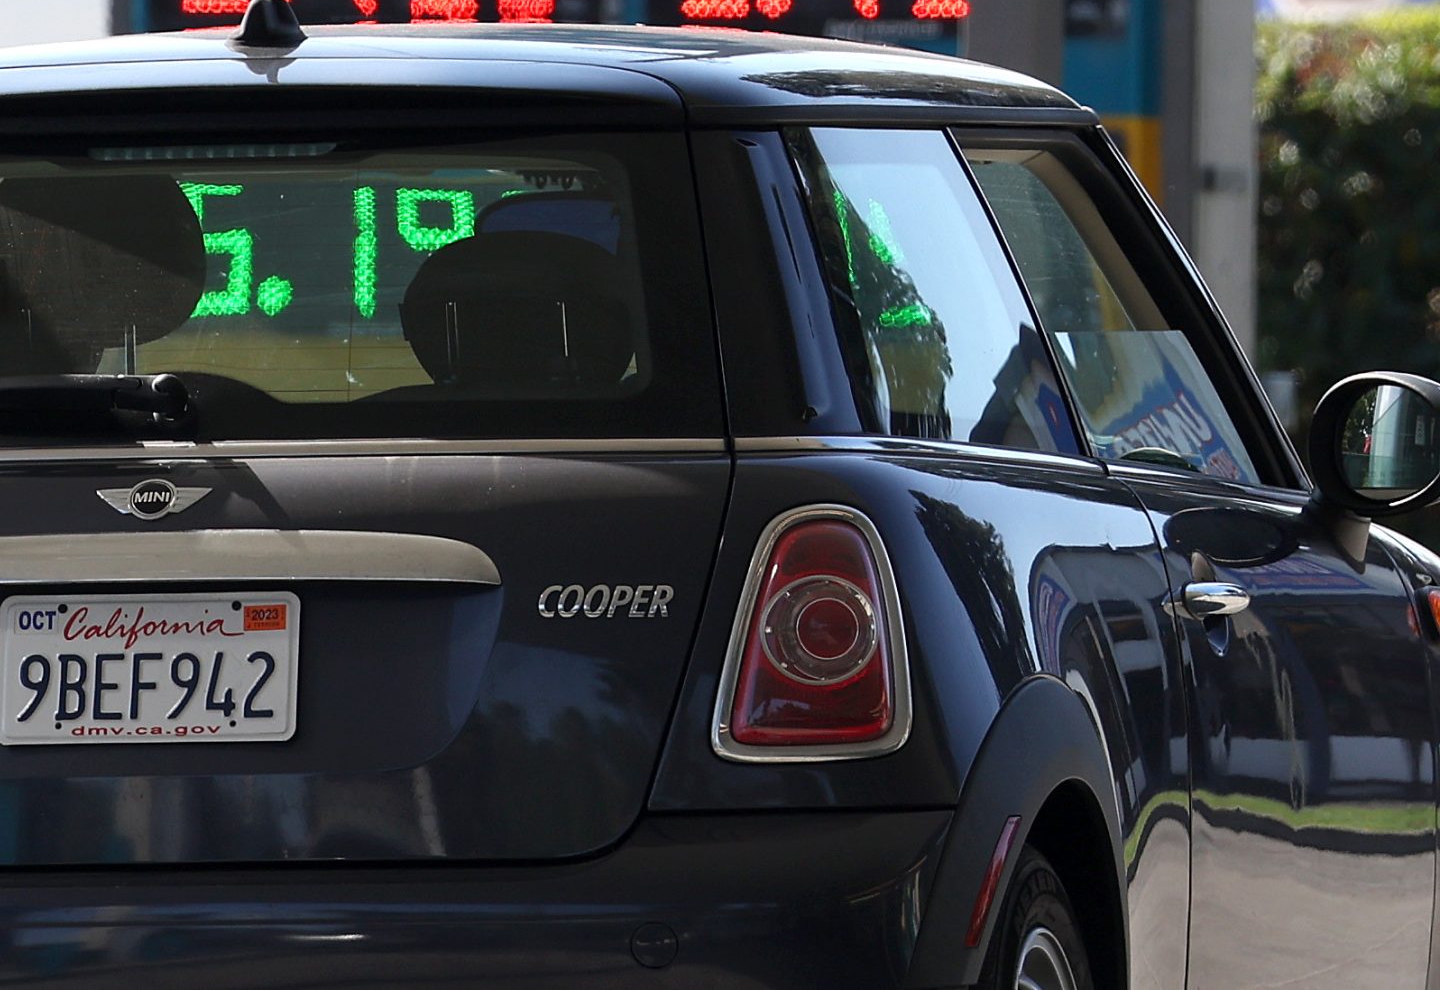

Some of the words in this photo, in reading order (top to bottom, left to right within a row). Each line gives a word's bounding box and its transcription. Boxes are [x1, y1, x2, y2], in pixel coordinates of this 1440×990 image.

[134, 491, 171, 503] MINI
[538, 584, 675, 618] COOPER
[19, 611, 56, 631] OCT
[251, 609, 279, 621] 2023
[63, 607, 245, 649] California
[17, 651, 276, 723] 9BEF942
[71, 725, 221, 737] dmv.ca.gov
